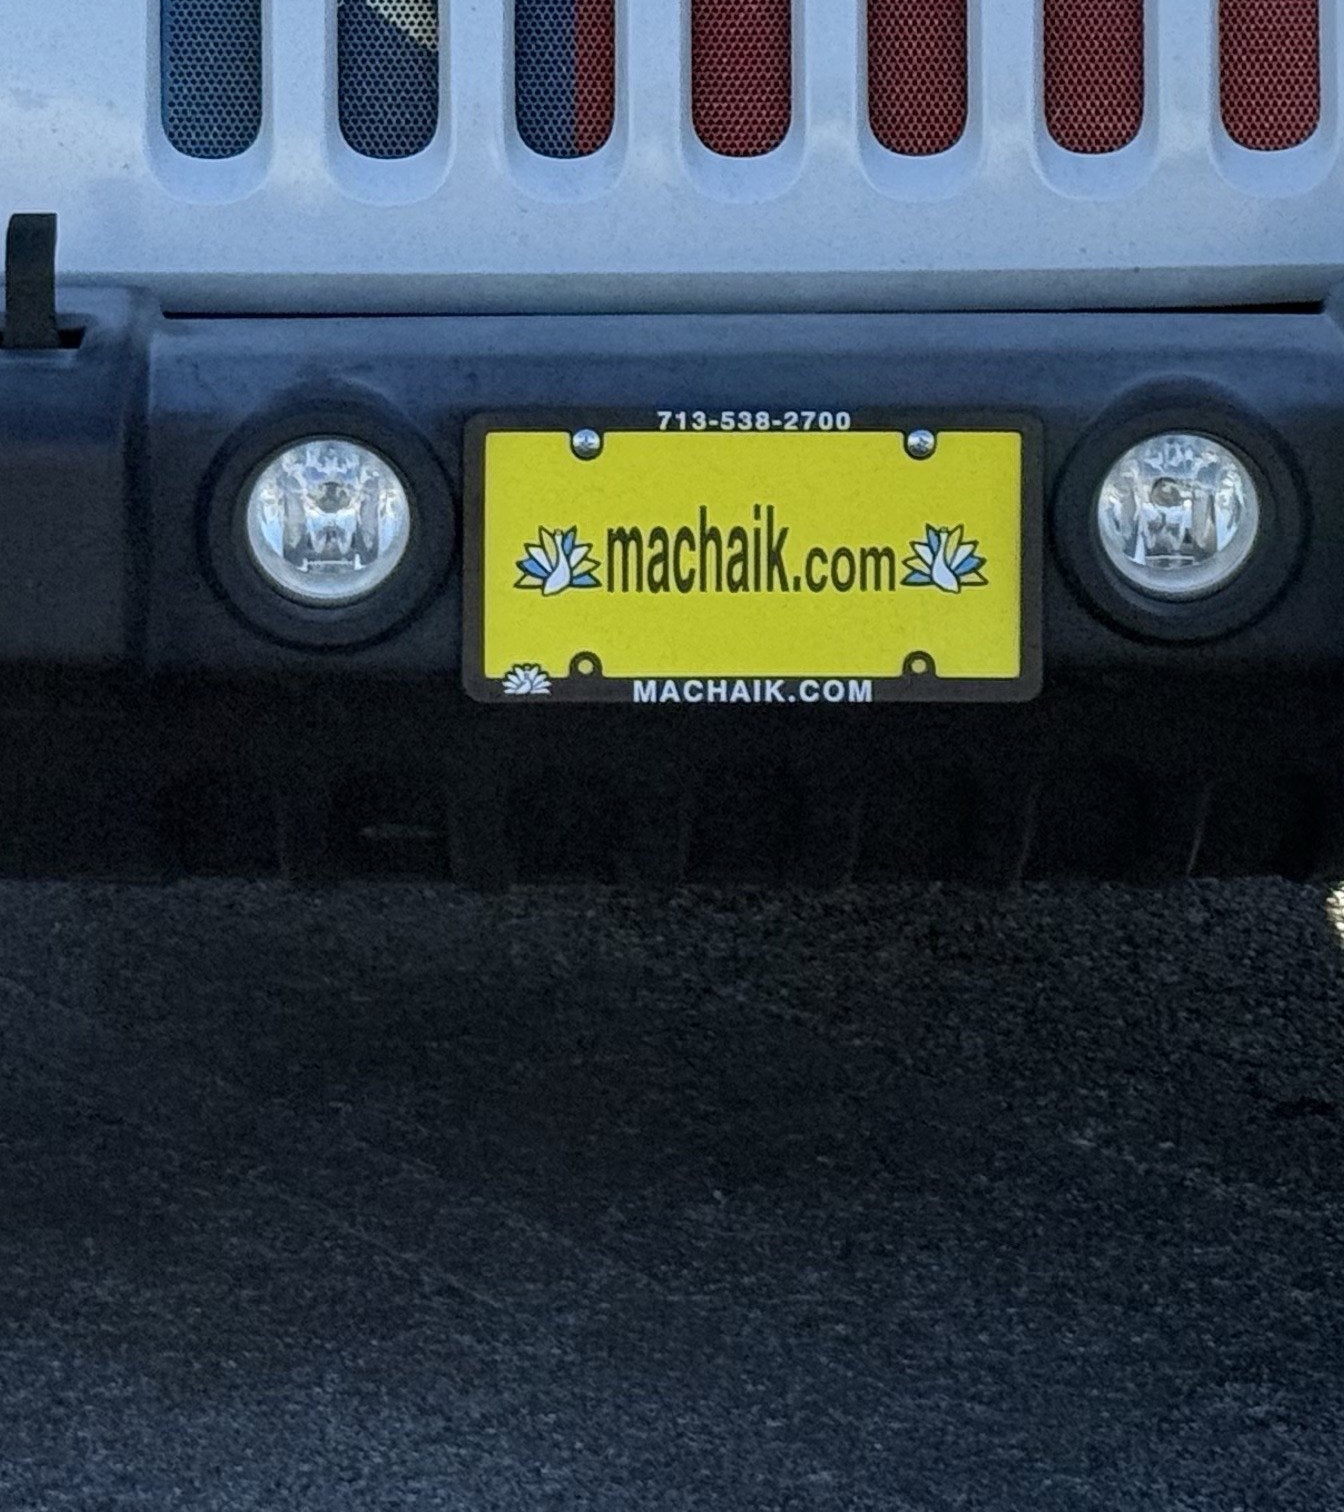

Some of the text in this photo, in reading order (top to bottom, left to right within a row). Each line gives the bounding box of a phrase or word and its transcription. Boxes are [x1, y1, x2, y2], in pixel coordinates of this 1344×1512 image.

[657, 410, 852, 432] 713-538-2700
[606, 503, 896, 593] machaik.com
[632, 678, 874, 704] MACHAIK.COM
